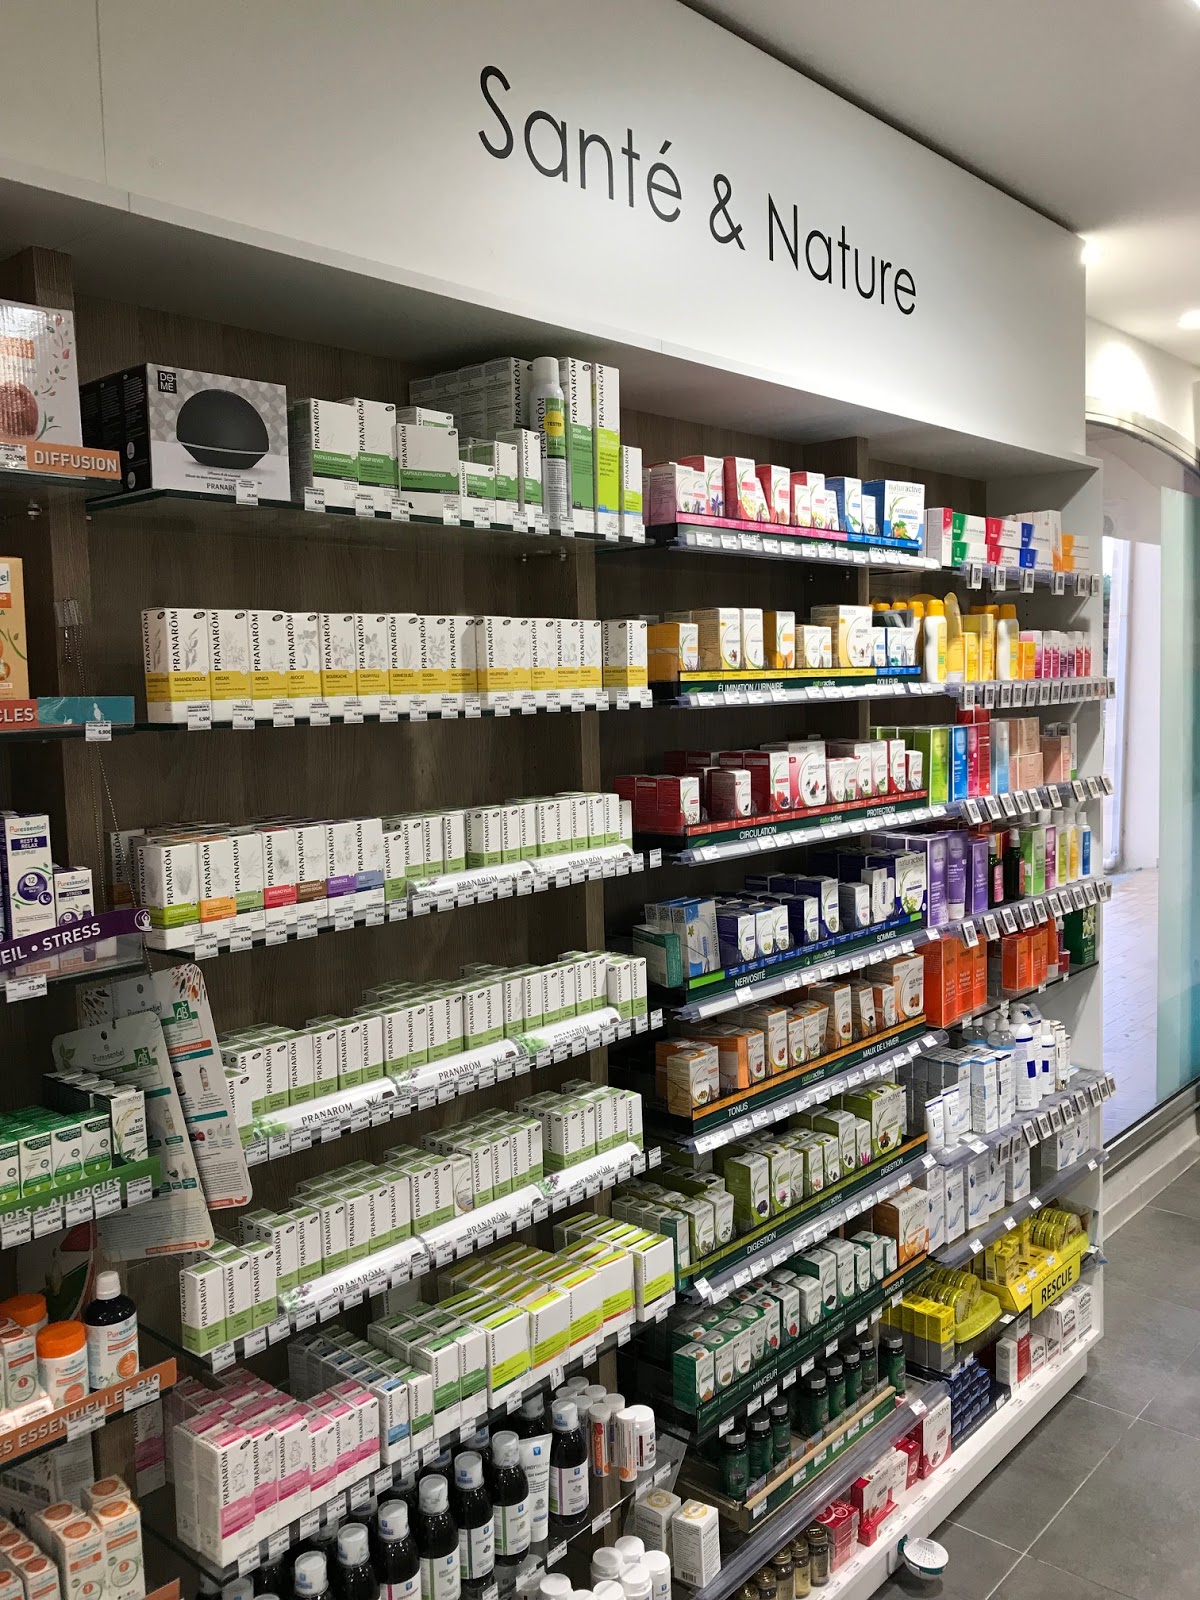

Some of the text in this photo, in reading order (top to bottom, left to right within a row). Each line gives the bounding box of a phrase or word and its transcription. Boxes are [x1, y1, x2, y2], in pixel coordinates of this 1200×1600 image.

[478, 65, 917, 315] Santé & Nature
[34, 450, 117, 472] DIFFUSION
[718, 682, 754, 692] ÉLIMINATION
[866, 806, 896, 818] PROTECTION
[10, 822, 47, 833] Puressentiel
[739, 826, 778, 840] CIRCULATION
[42, 922, 101, 952] STRESS
[876, 930, 898, 943] SOMMEIL
[734, 972, 766, 988] NERVOSITÉ
[728, 1102, 749, 1117] TONUS
[881, 1157, 904, 1176] DIGESTION
[746, 1232, 778, 1254] DIGESTION
[884, 1278, 905, 1295] MINCEUR
[1041, 1264, 1073, 1304] RESCUE
[752, 1368, 778, 1392] MINCEUR
